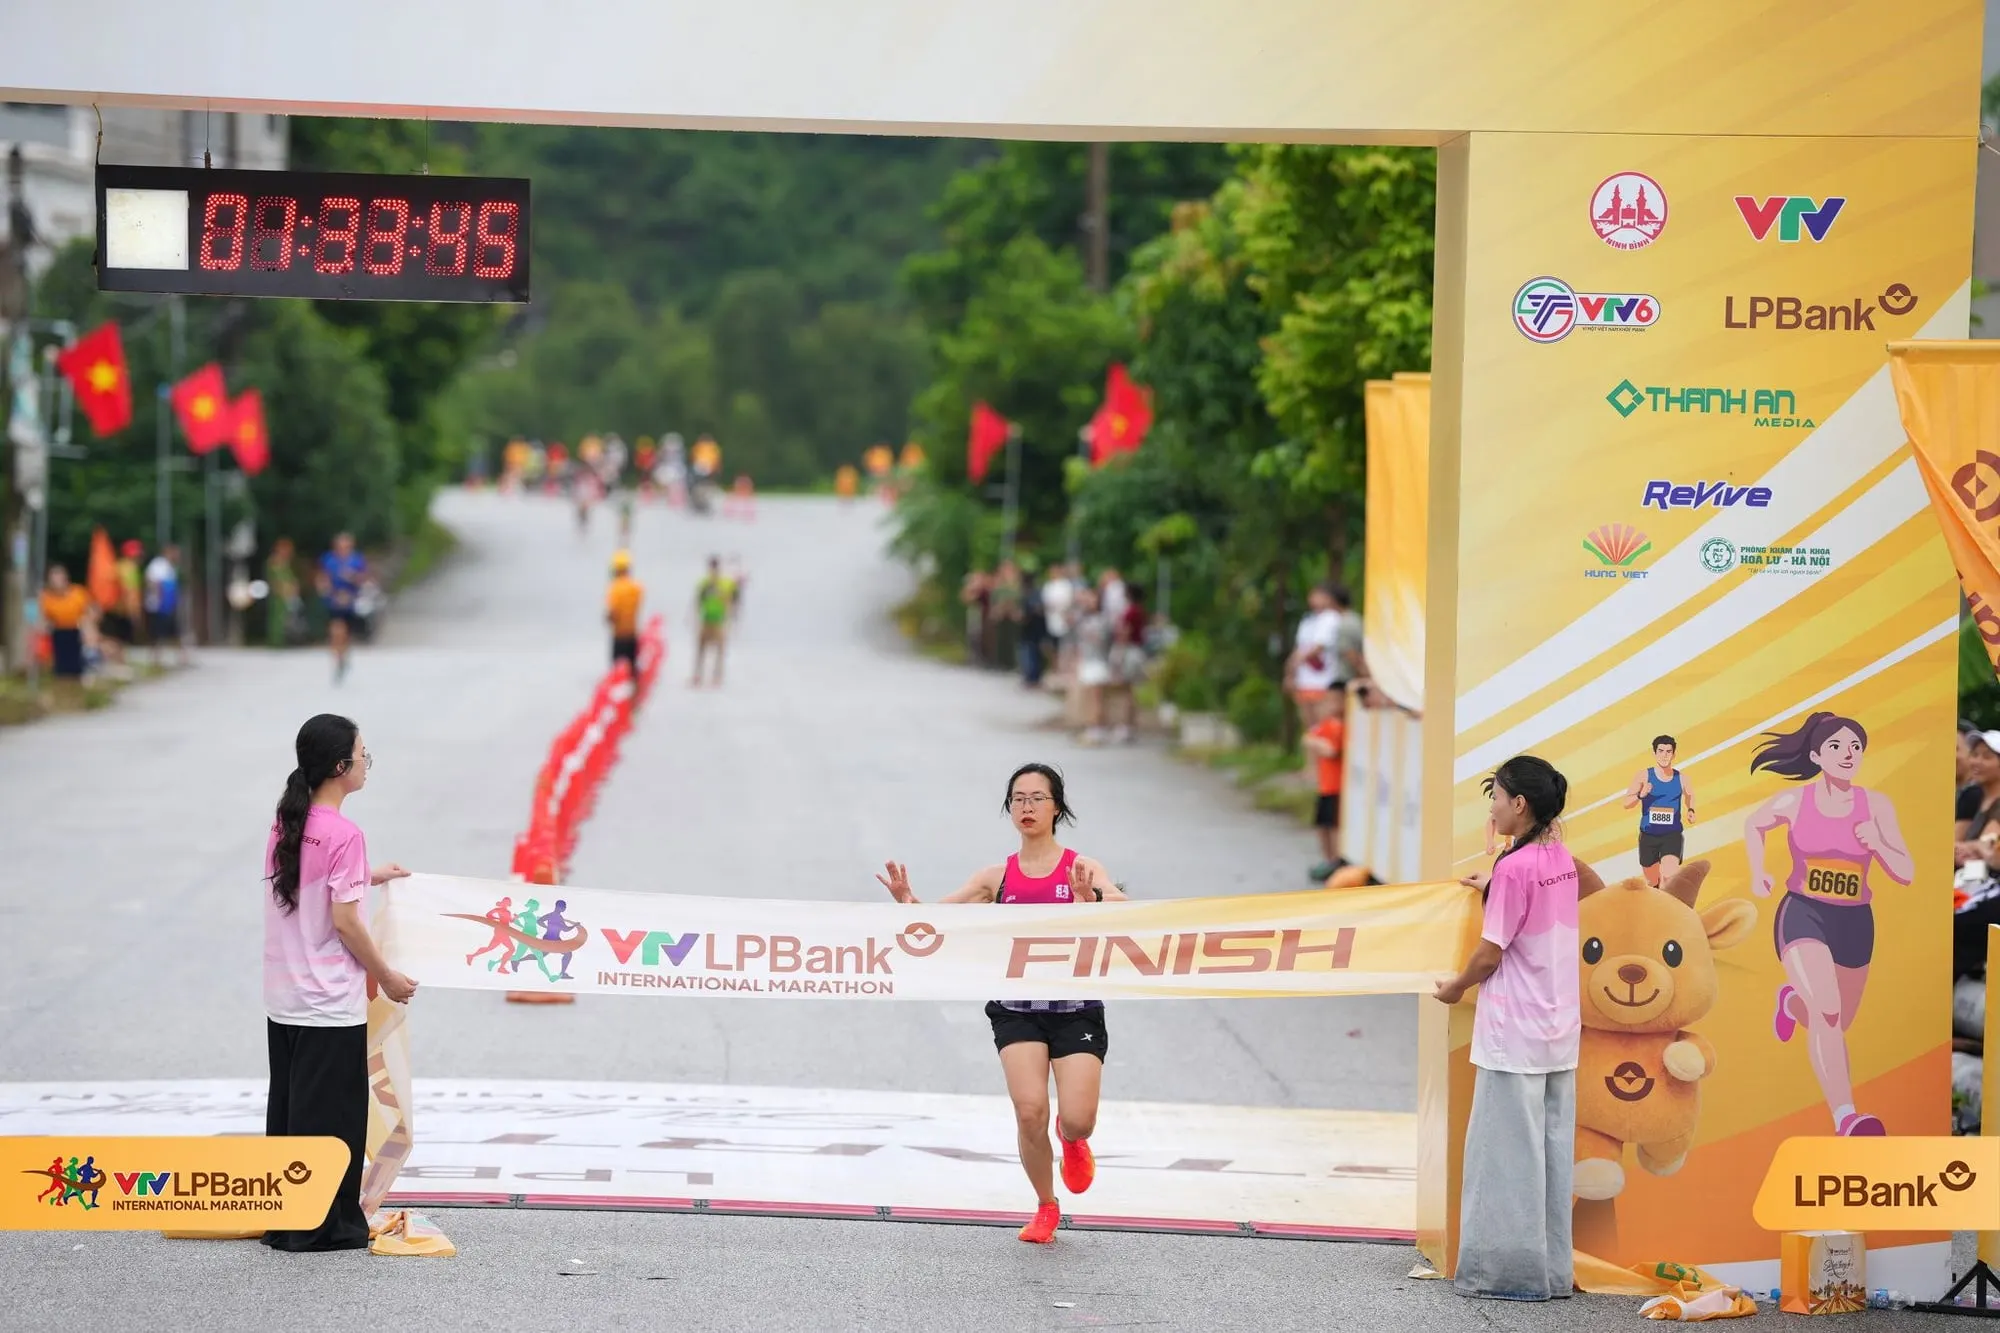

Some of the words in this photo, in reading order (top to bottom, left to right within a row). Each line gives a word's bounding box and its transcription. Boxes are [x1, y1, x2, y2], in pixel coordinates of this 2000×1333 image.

[1735, 197, 1845, 242] VTV
[200, 193, 519, 279] 01:33:45
[1605, 237, 1628, 249] NINH
[1578, 297, 1653, 323] VTV6
[1725, 296, 1876, 332] LPBank
[1646, 387, 1746, 414] THANH
[1754, 389, 1795, 415] AN
[1754, 418, 1815, 428] MEDIA
[1740, 555, 1763, 564] HOA
[1651, 813, 1671, 823] 8888
[1808, 868, 1859, 897] 6666
[601, 928, 700, 966] VTV
[706, 932, 893, 975] LPBank
[1005, 927, 1357, 979] FINISH
[598, 971, 764, 993] INTERNATIONAL
[768, 979, 894, 995] MARATHON
